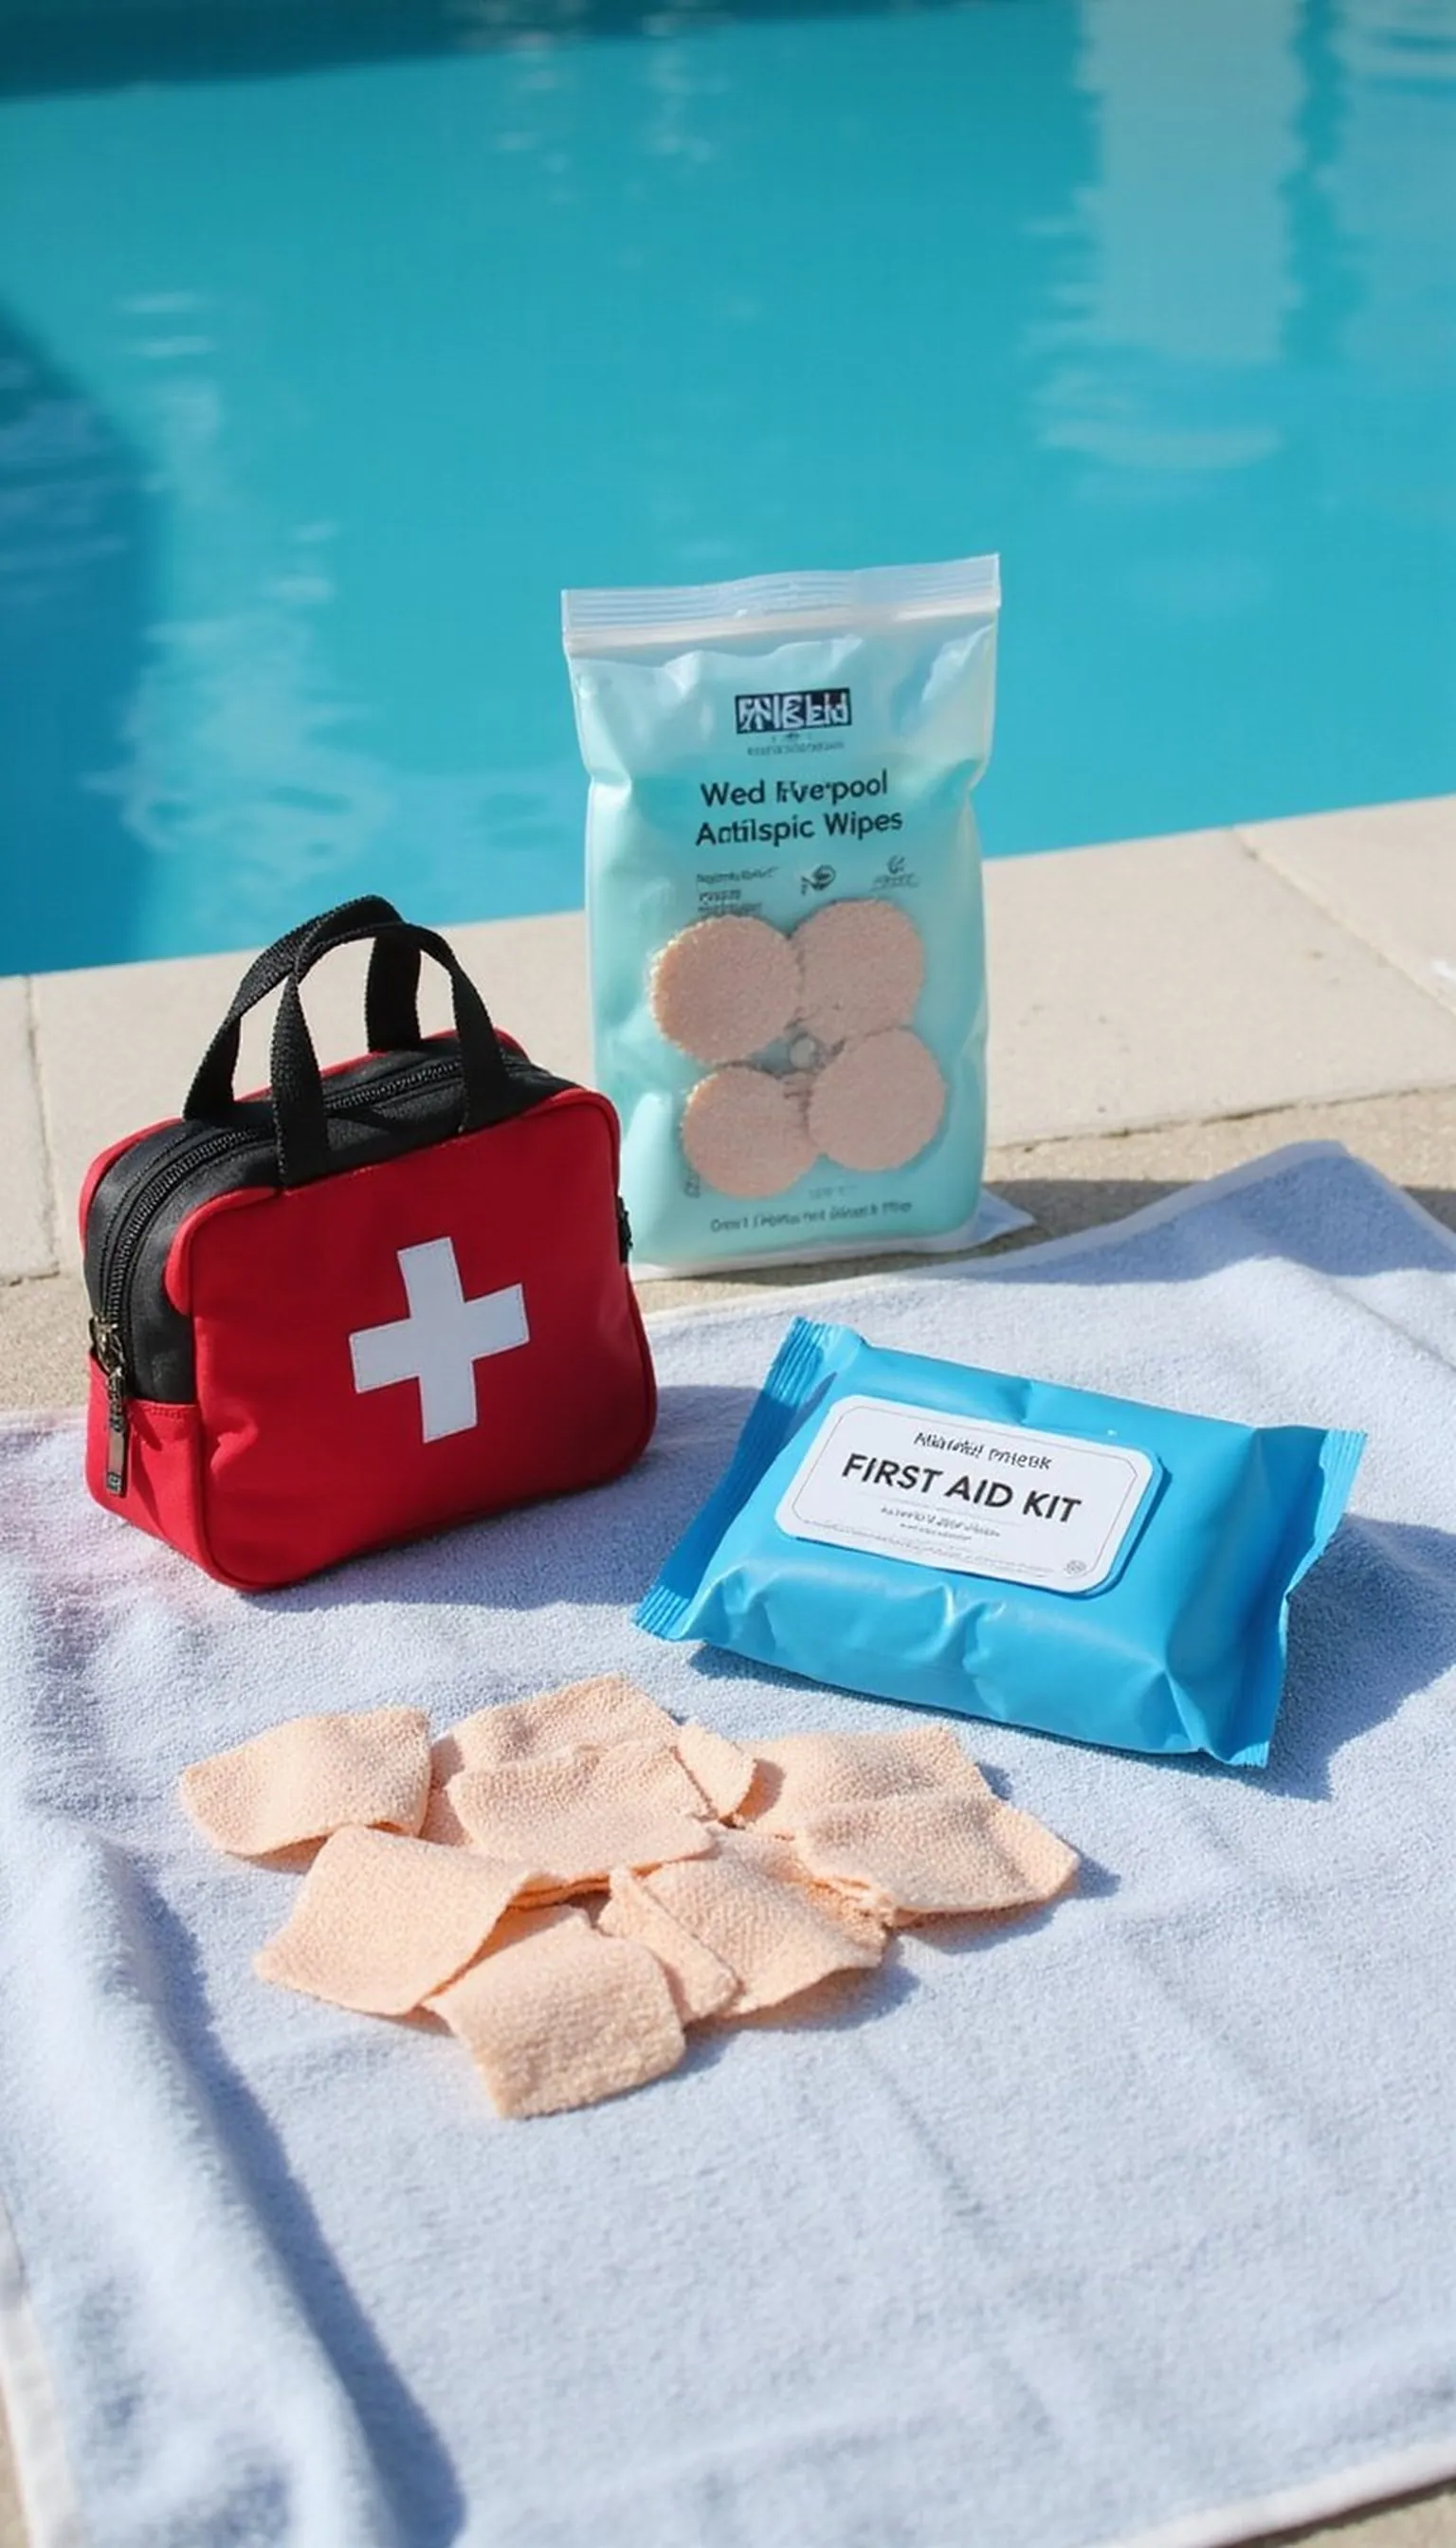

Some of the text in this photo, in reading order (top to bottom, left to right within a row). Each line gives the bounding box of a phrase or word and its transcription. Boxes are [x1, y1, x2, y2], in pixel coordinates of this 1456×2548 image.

[701, 778, 766, 808] Wed
[824, 810, 903, 841] Wipes
[842, 1452, 943, 1494] FIRST
[946, 1474, 1013, 1508] AID
[1022, 1489, 1082, 1522] KIT
